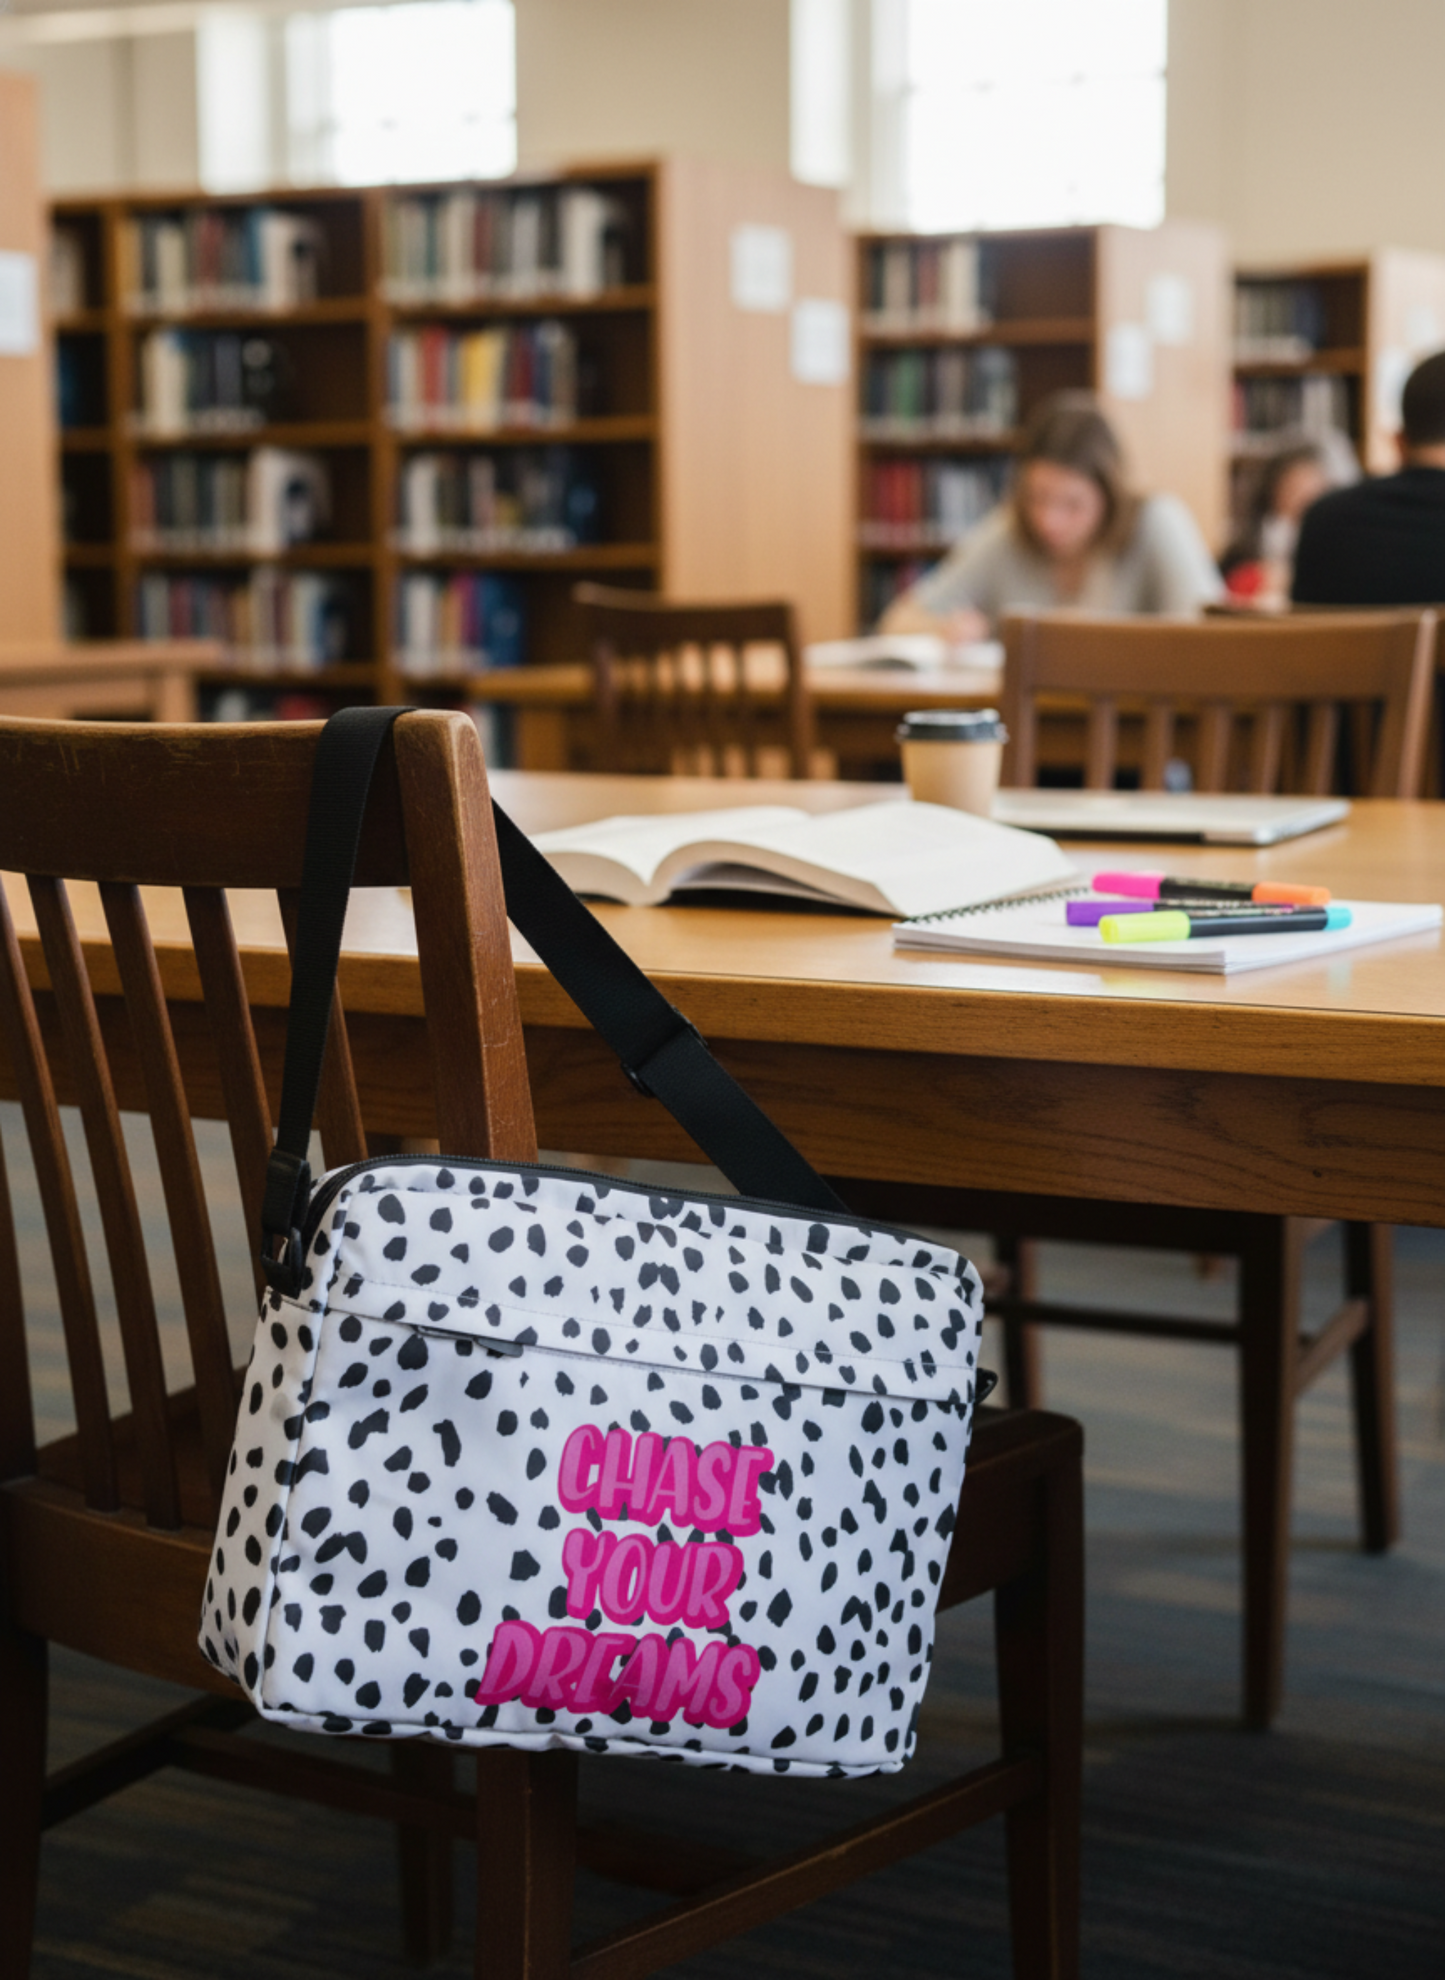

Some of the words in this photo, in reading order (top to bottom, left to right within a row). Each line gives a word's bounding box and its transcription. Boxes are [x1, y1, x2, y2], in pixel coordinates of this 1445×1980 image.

[558, 1424, 774, 1537] CHASE
[562, 1528, 744, 1629] YOUR
[474, 1620, 761, 1729] DREAMS
